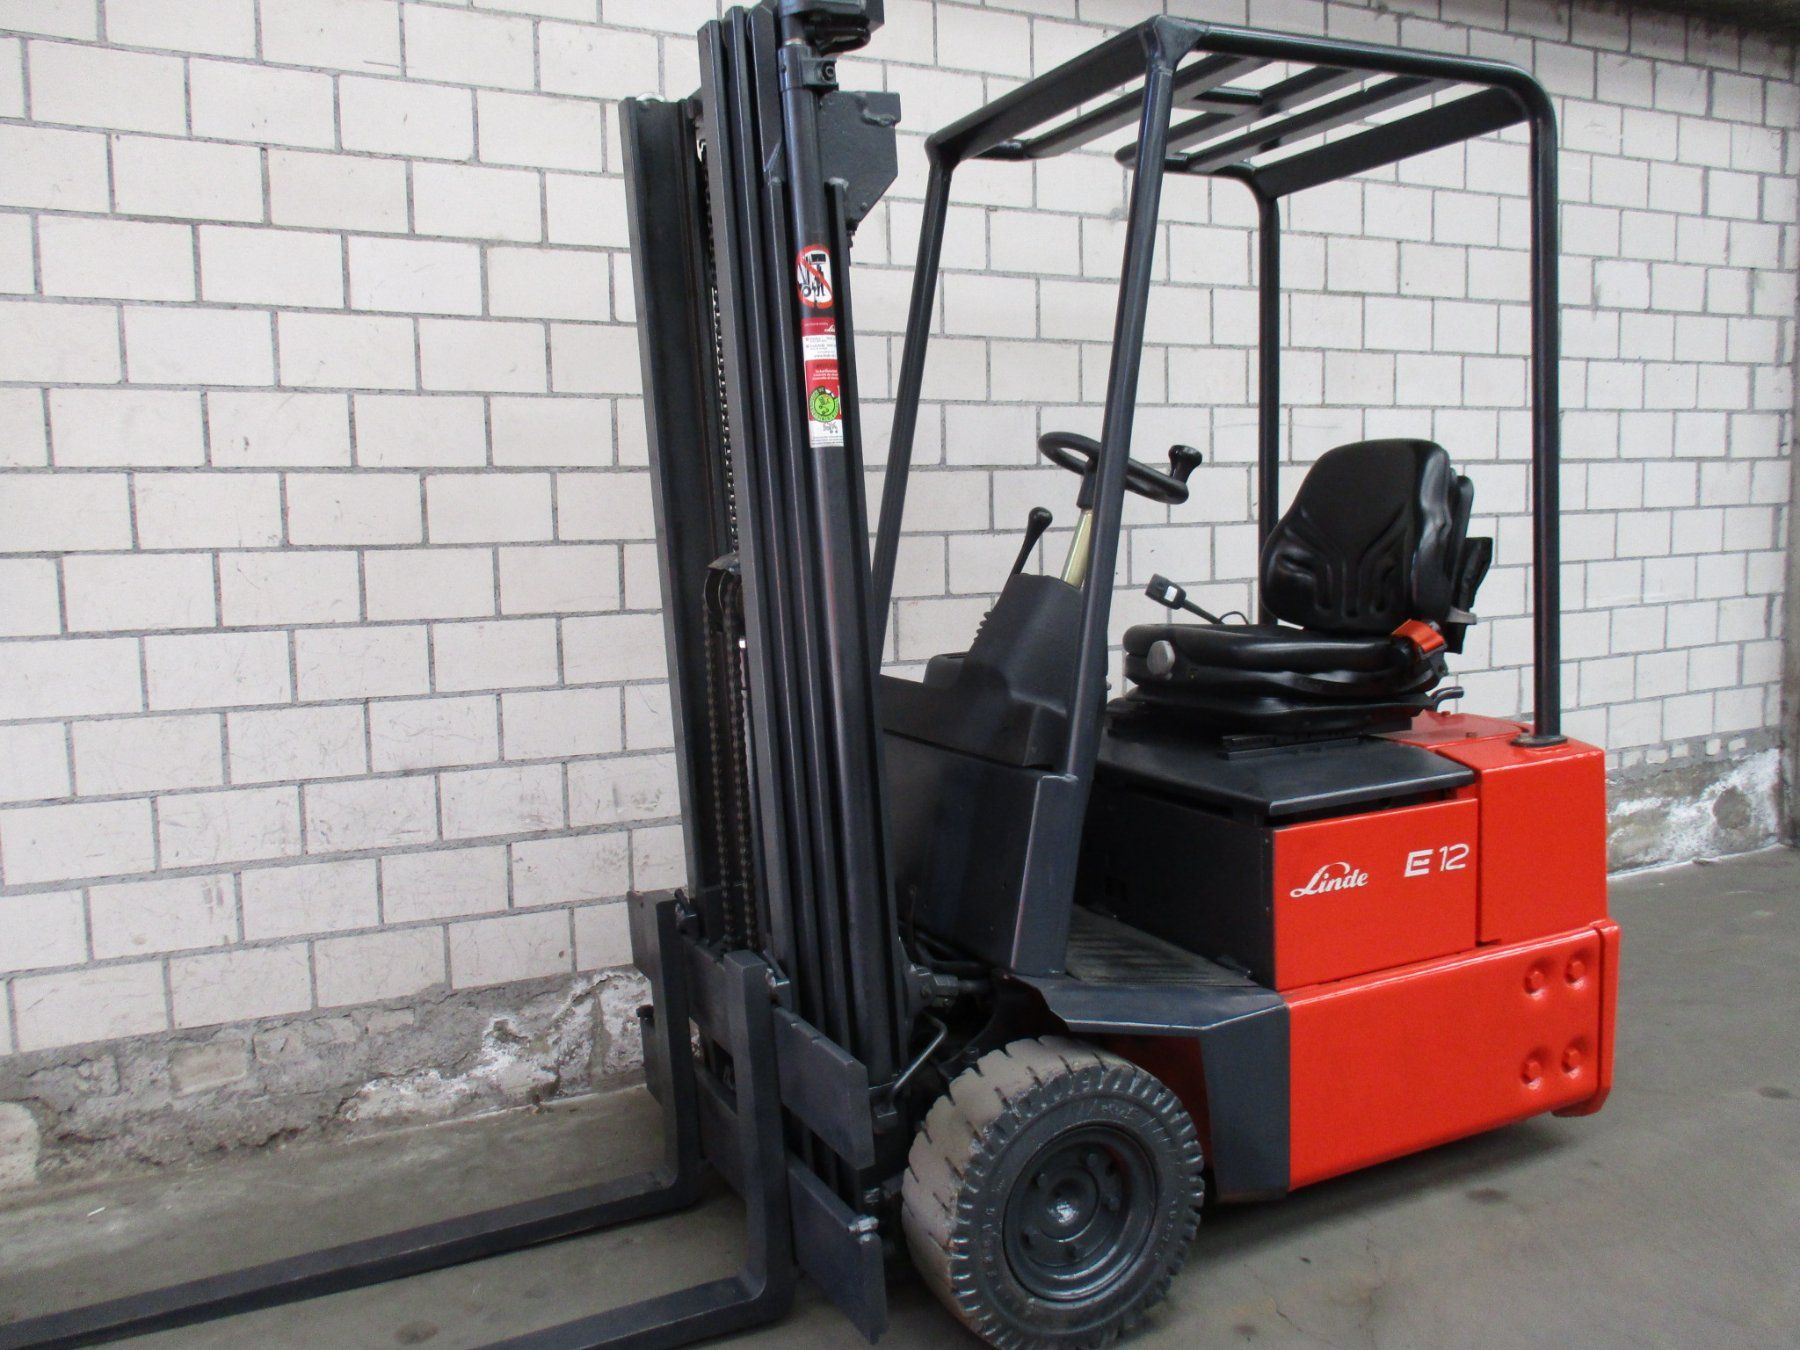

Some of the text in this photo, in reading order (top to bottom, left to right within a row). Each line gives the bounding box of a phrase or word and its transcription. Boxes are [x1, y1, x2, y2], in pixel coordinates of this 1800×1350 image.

[1404, 843, 1470, 877] E 12
[1290, 861, 1369, 897] Linde
